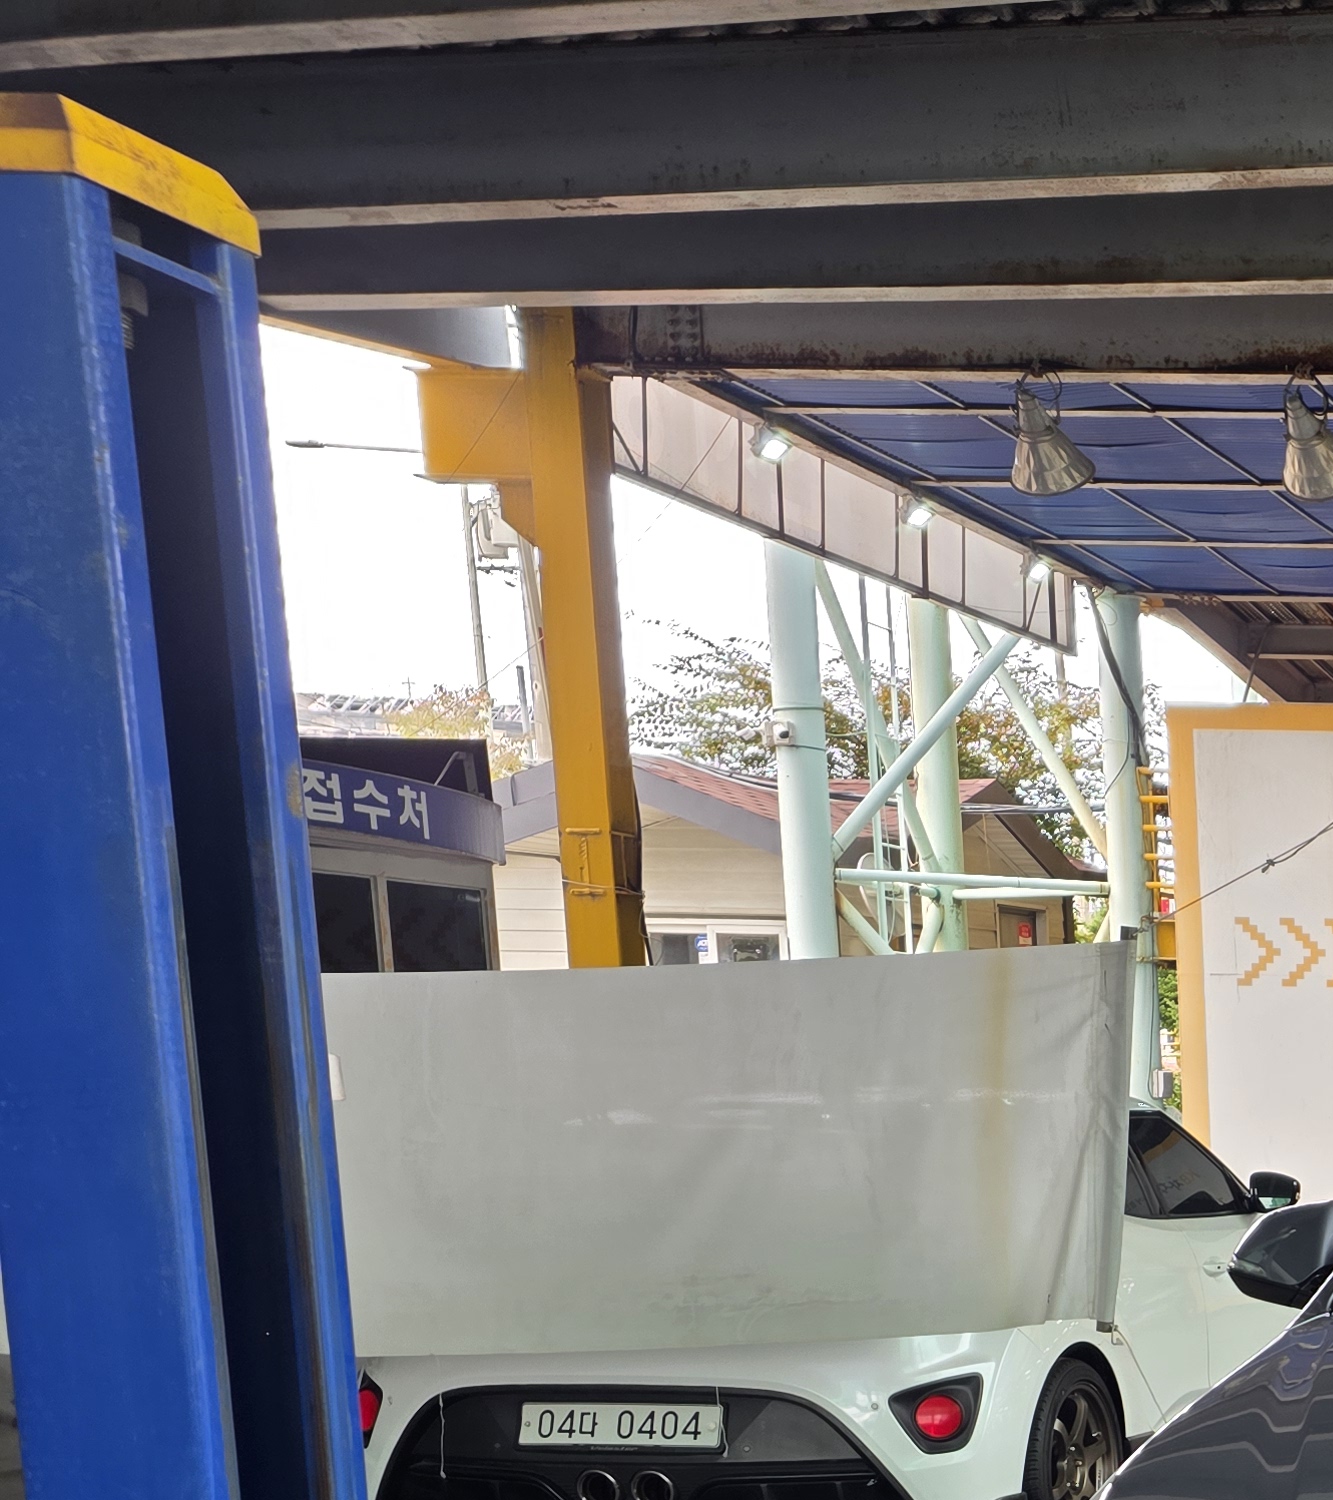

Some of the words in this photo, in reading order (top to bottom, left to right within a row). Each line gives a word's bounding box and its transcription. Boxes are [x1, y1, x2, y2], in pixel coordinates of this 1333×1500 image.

[302, 767, 431, 840] 접수처
[537, 1408, 599, 1439] 04다
[616, 1409, 702, 1441] 0404
